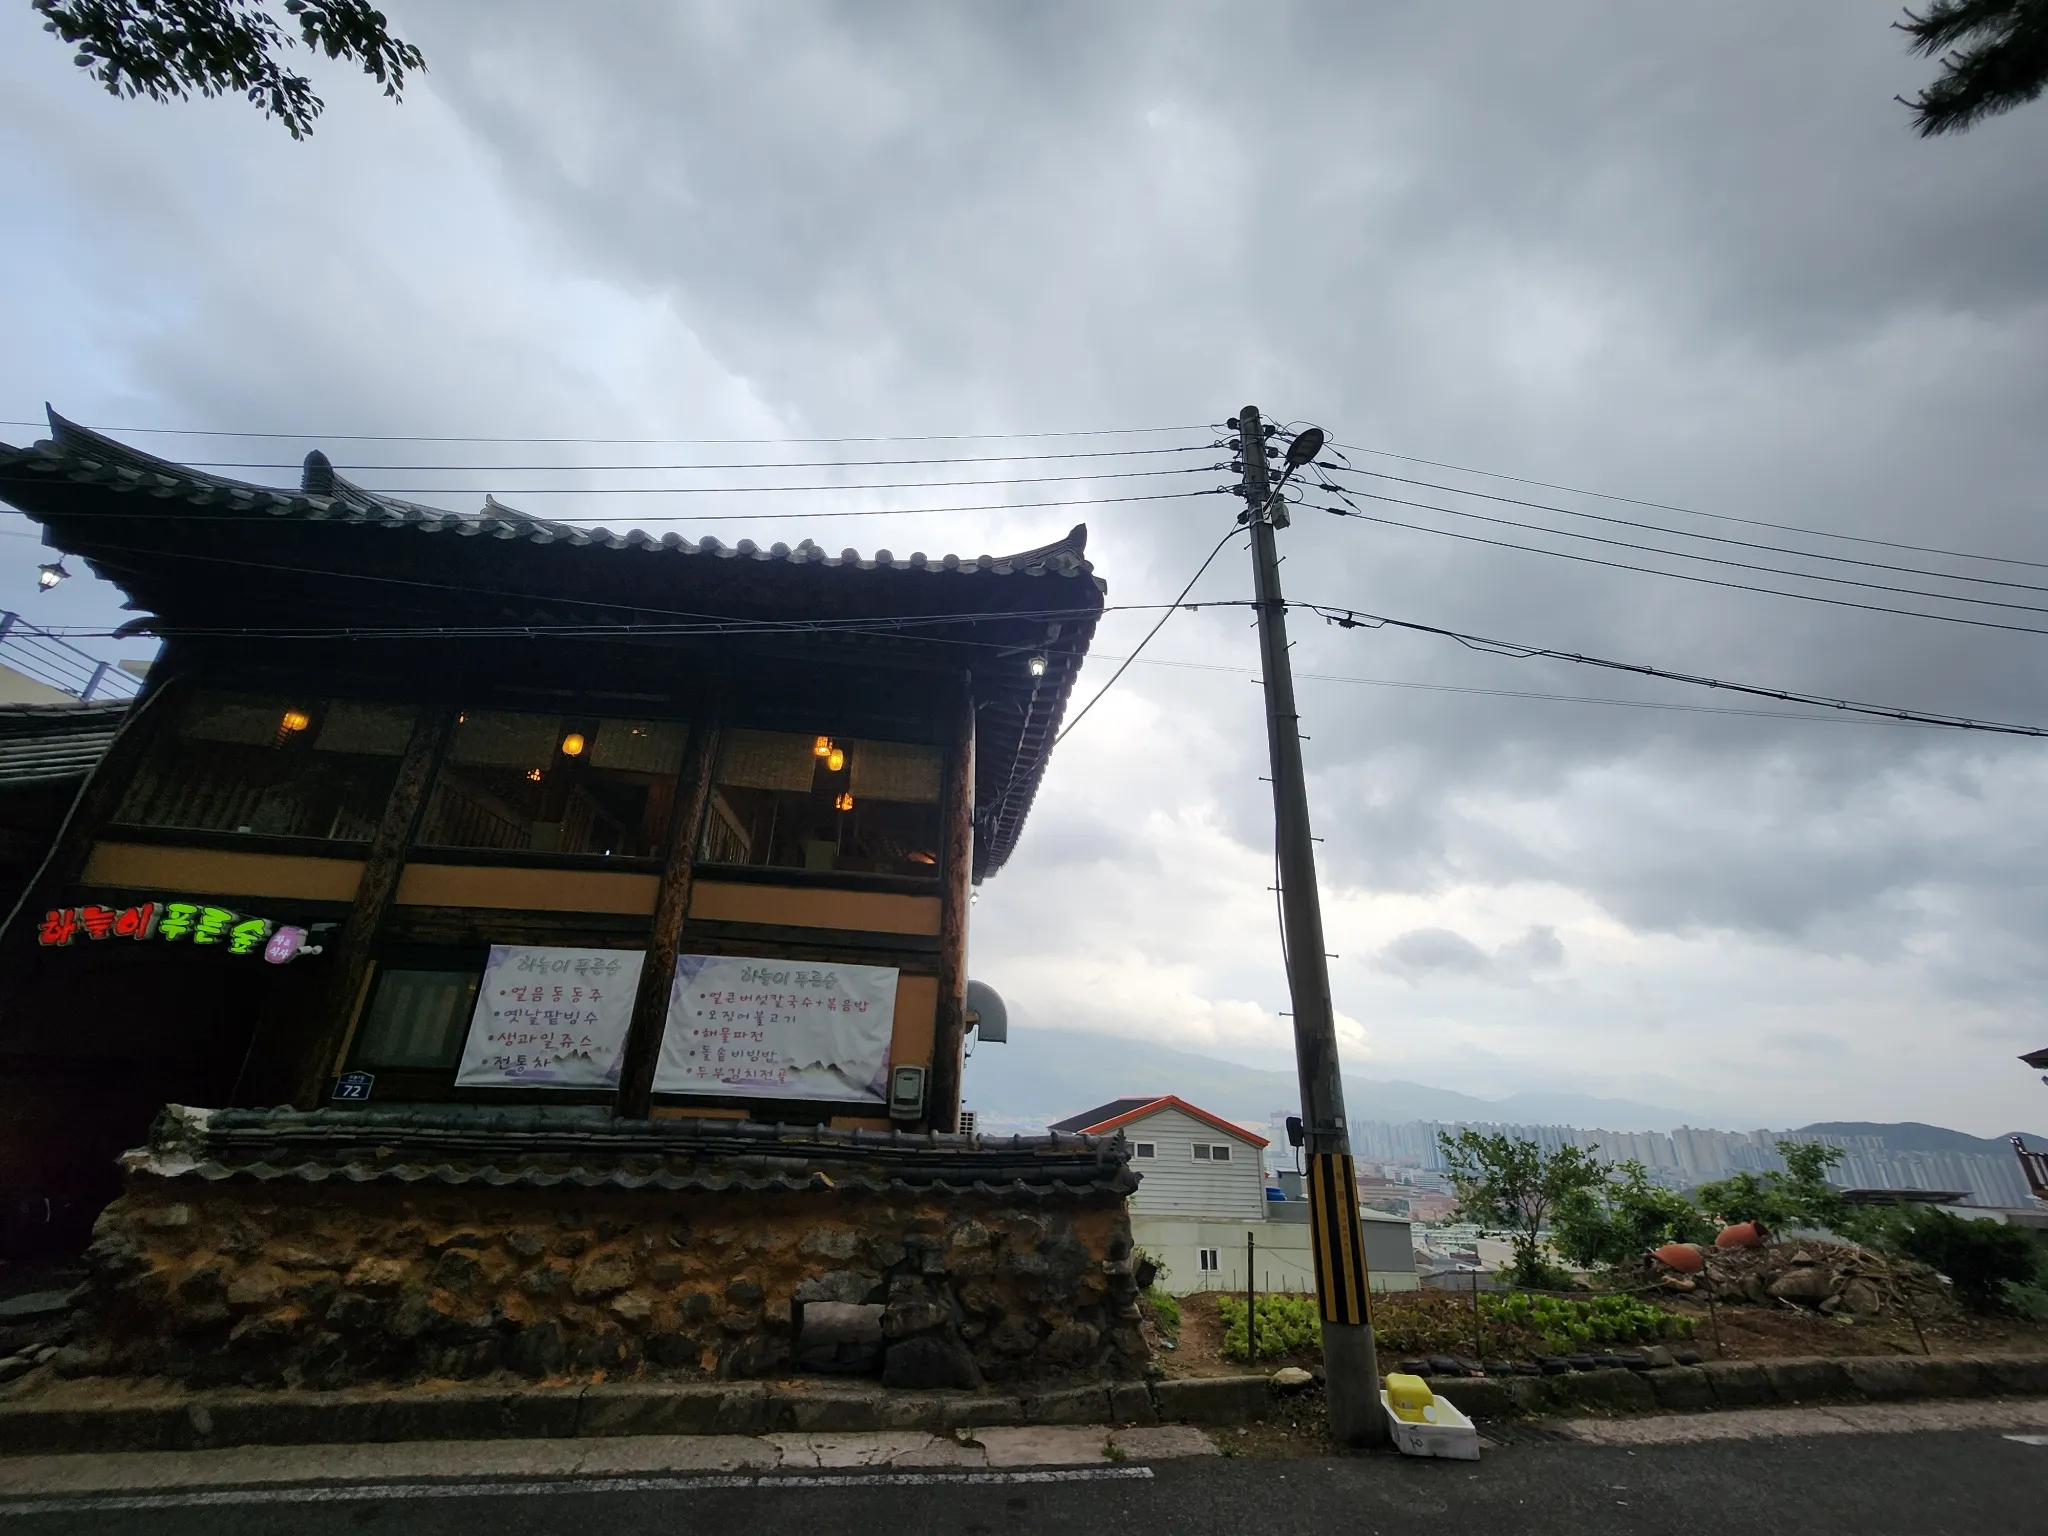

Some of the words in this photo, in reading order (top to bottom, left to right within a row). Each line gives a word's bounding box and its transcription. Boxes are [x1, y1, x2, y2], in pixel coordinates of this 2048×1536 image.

[38, 902, 155, 945] 하늘이
[159, 902, 266, 954] 푸른숲
[517, 955, 572, 975] 하늘이
[574, 958, 622, 976] 푸른숲
[741, 966, 791, 987] 하늘이
[794, 970, 839, 990] 푸른숲
[511, 986, 604, 1003] 얼음동동주
[504, 1008, 598, 1026] 옛날팥빙수
[497, 1032, 592, 1050] 생과일쥬스
[702, 1028, 764, 1044] 해물파전
[700, 1045, 777, 1063] 돌솥비빔밥
[493, 1054, 553, 1073] 전통차
[343, 1085, 361, 1096] 72
